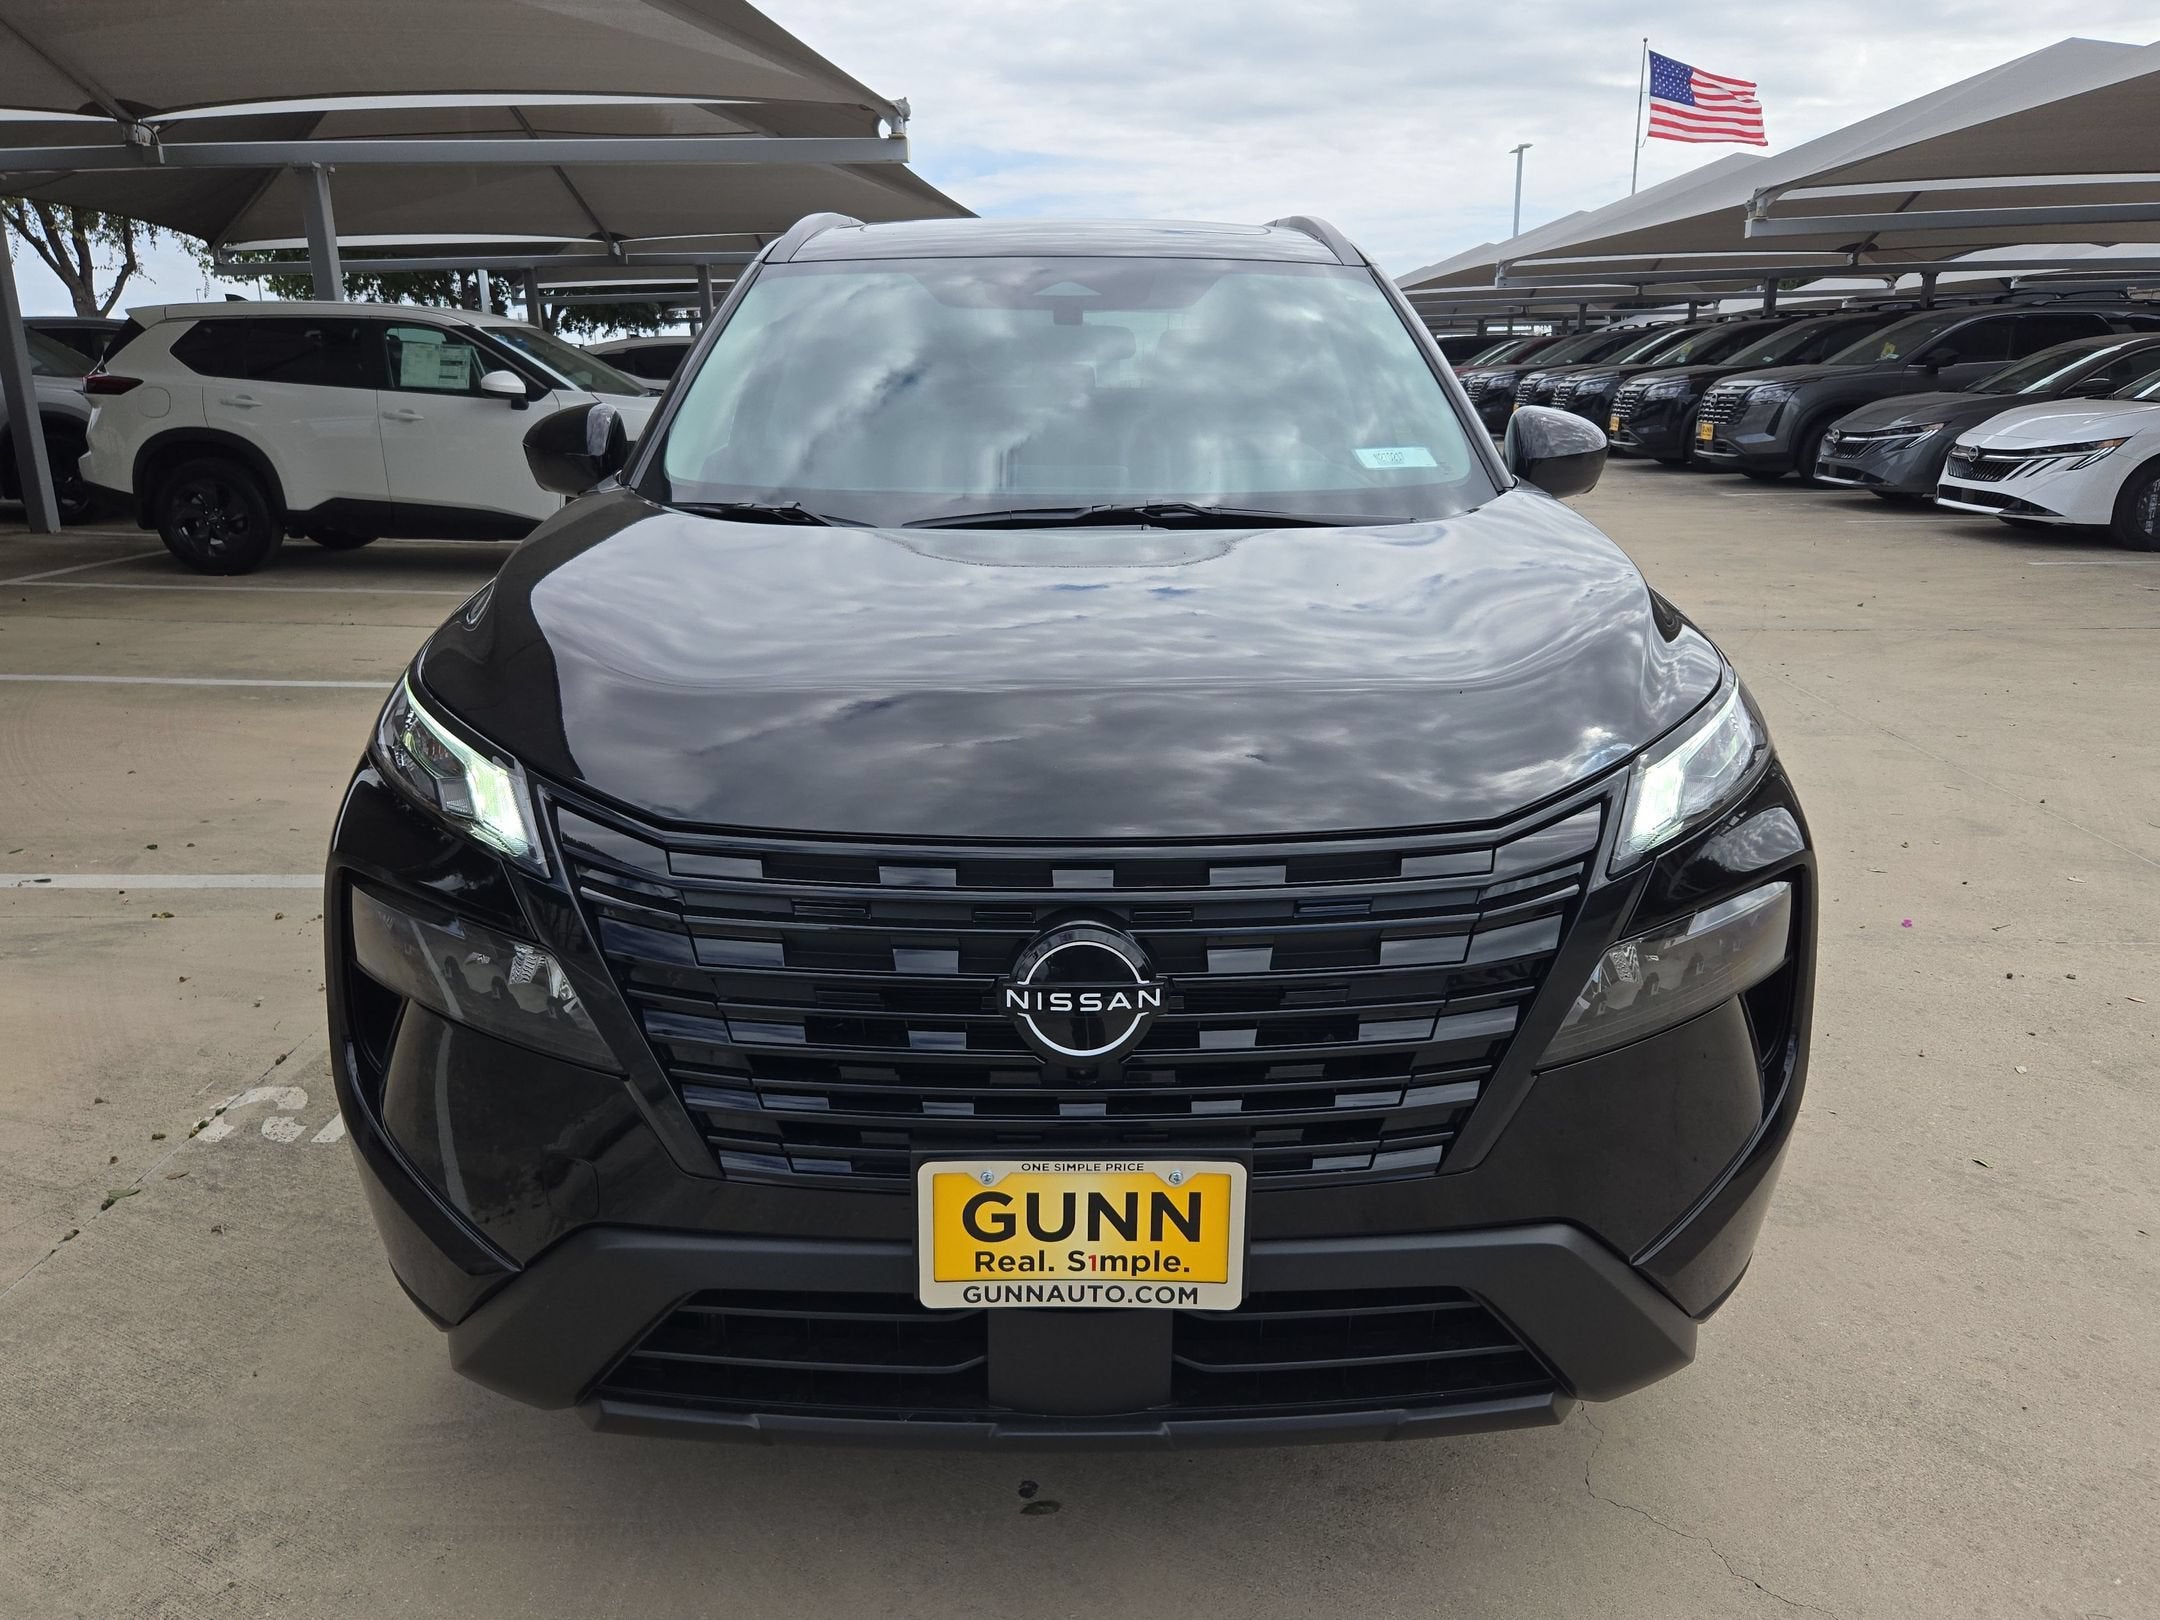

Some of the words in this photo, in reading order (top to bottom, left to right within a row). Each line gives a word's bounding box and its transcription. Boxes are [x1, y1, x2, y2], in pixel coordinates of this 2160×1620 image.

[1006, 988, 1161, 1011] NISSAN
[1021, 1163, 1049, 1171] ONE
[1054, 1163, 1100, 1171] SIMPLE
[1105, 1162, 1144, 1171] PRICE
[962, 1191, 1201, 1242] GUNN
[975, 1250, 1054, 1272] Real.
[963, 1285, 1198, 1304] GUNNAUTO.COM
